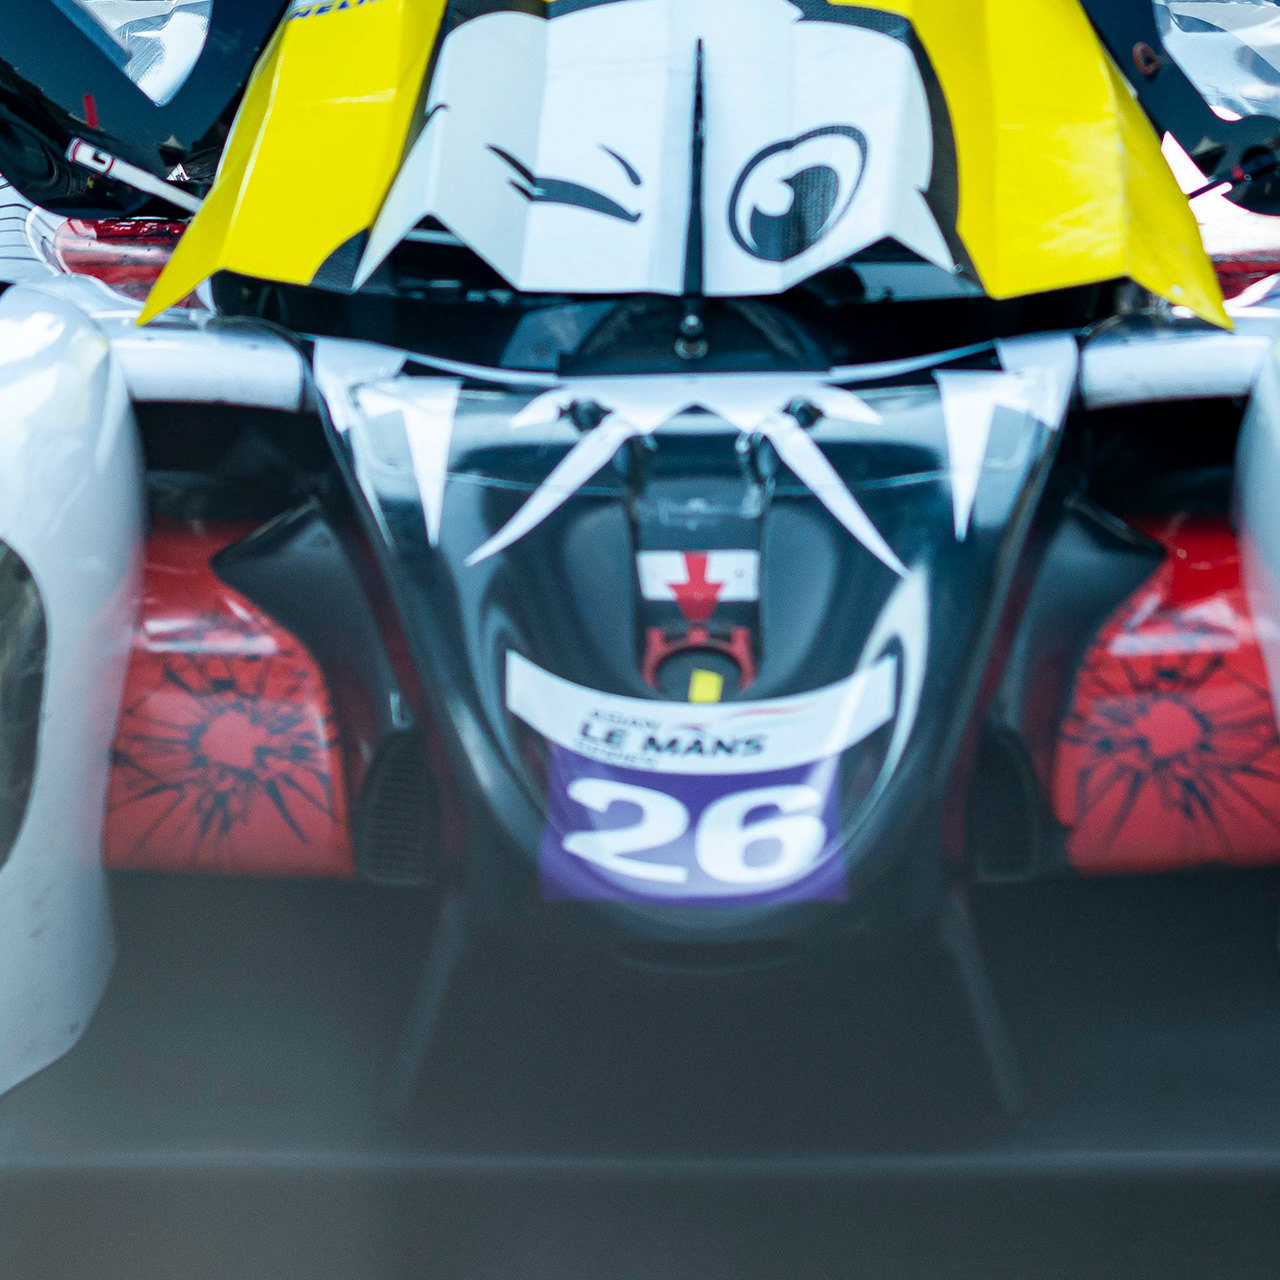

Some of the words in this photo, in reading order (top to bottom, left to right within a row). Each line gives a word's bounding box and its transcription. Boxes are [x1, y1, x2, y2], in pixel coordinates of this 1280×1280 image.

[580, 721, 627, 745] LE
[641, 732, 767, 757] MANS
[561, 777, 827, 885] 26
